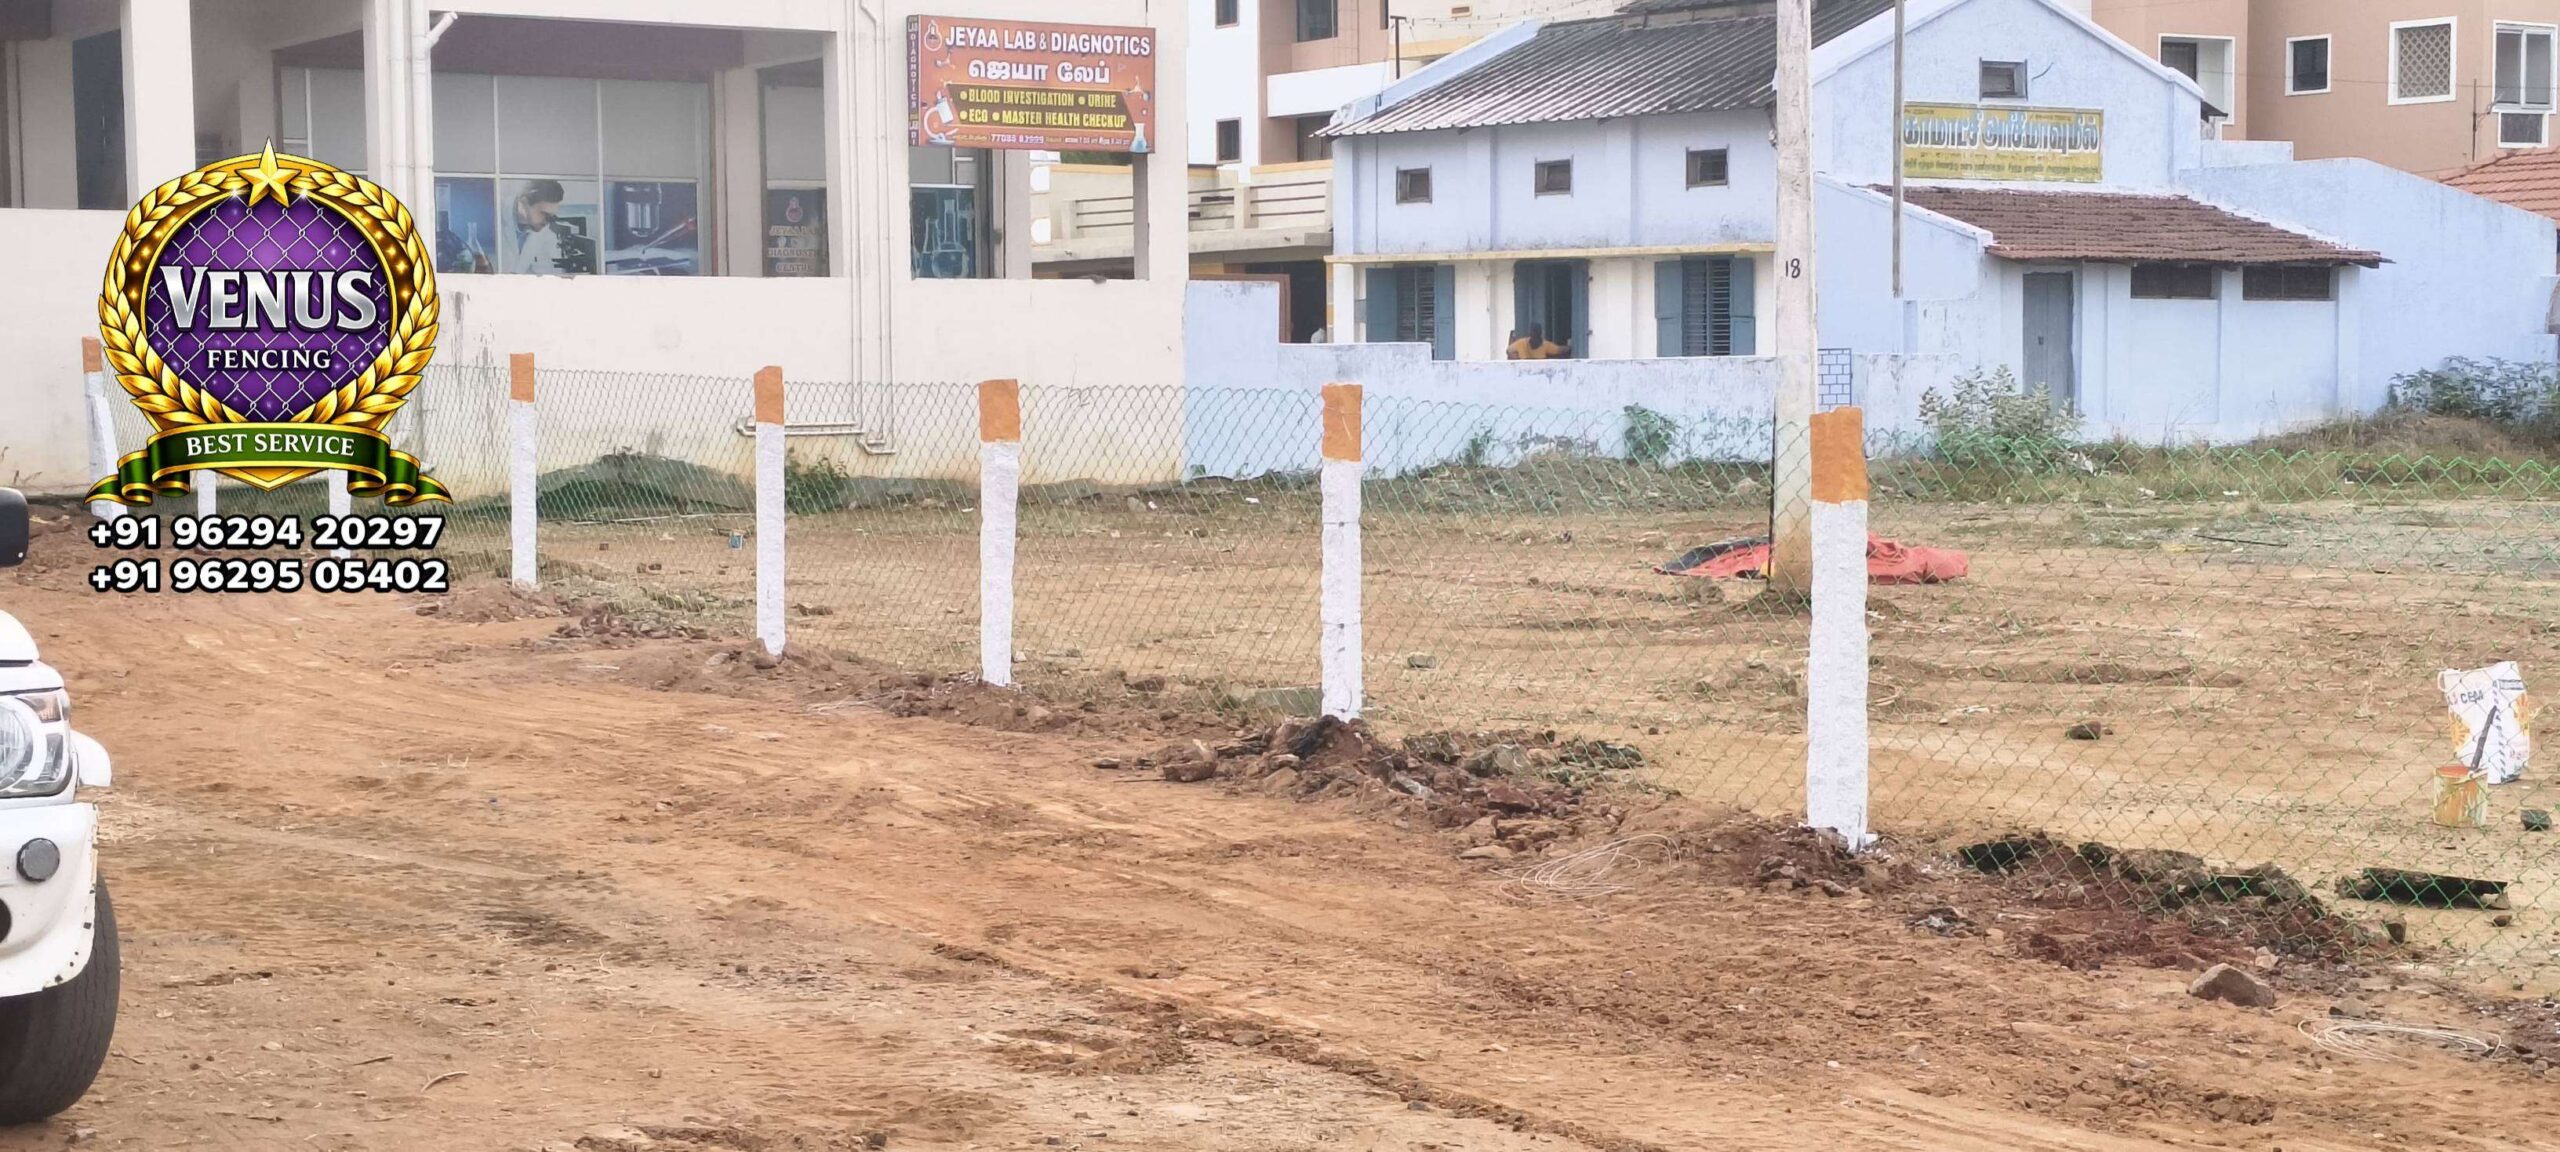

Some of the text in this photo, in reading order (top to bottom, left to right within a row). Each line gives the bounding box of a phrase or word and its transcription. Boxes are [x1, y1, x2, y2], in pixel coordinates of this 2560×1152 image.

[945, 26, 1151, 56] JEYAA LAB & DIAGNOTICS
[968, 59, 1111, 84] ஜெயா லேப்
[969, 88, 1117, 108] BLOOD INVESTIGATION URINE
[1002, 109, 1042, 125] MASTER
[1045, 111, 1080, 127] HEALTH
[1082, 113, 1127, 129] CHECKUP
[1785, 258, 1801, 278] 18
